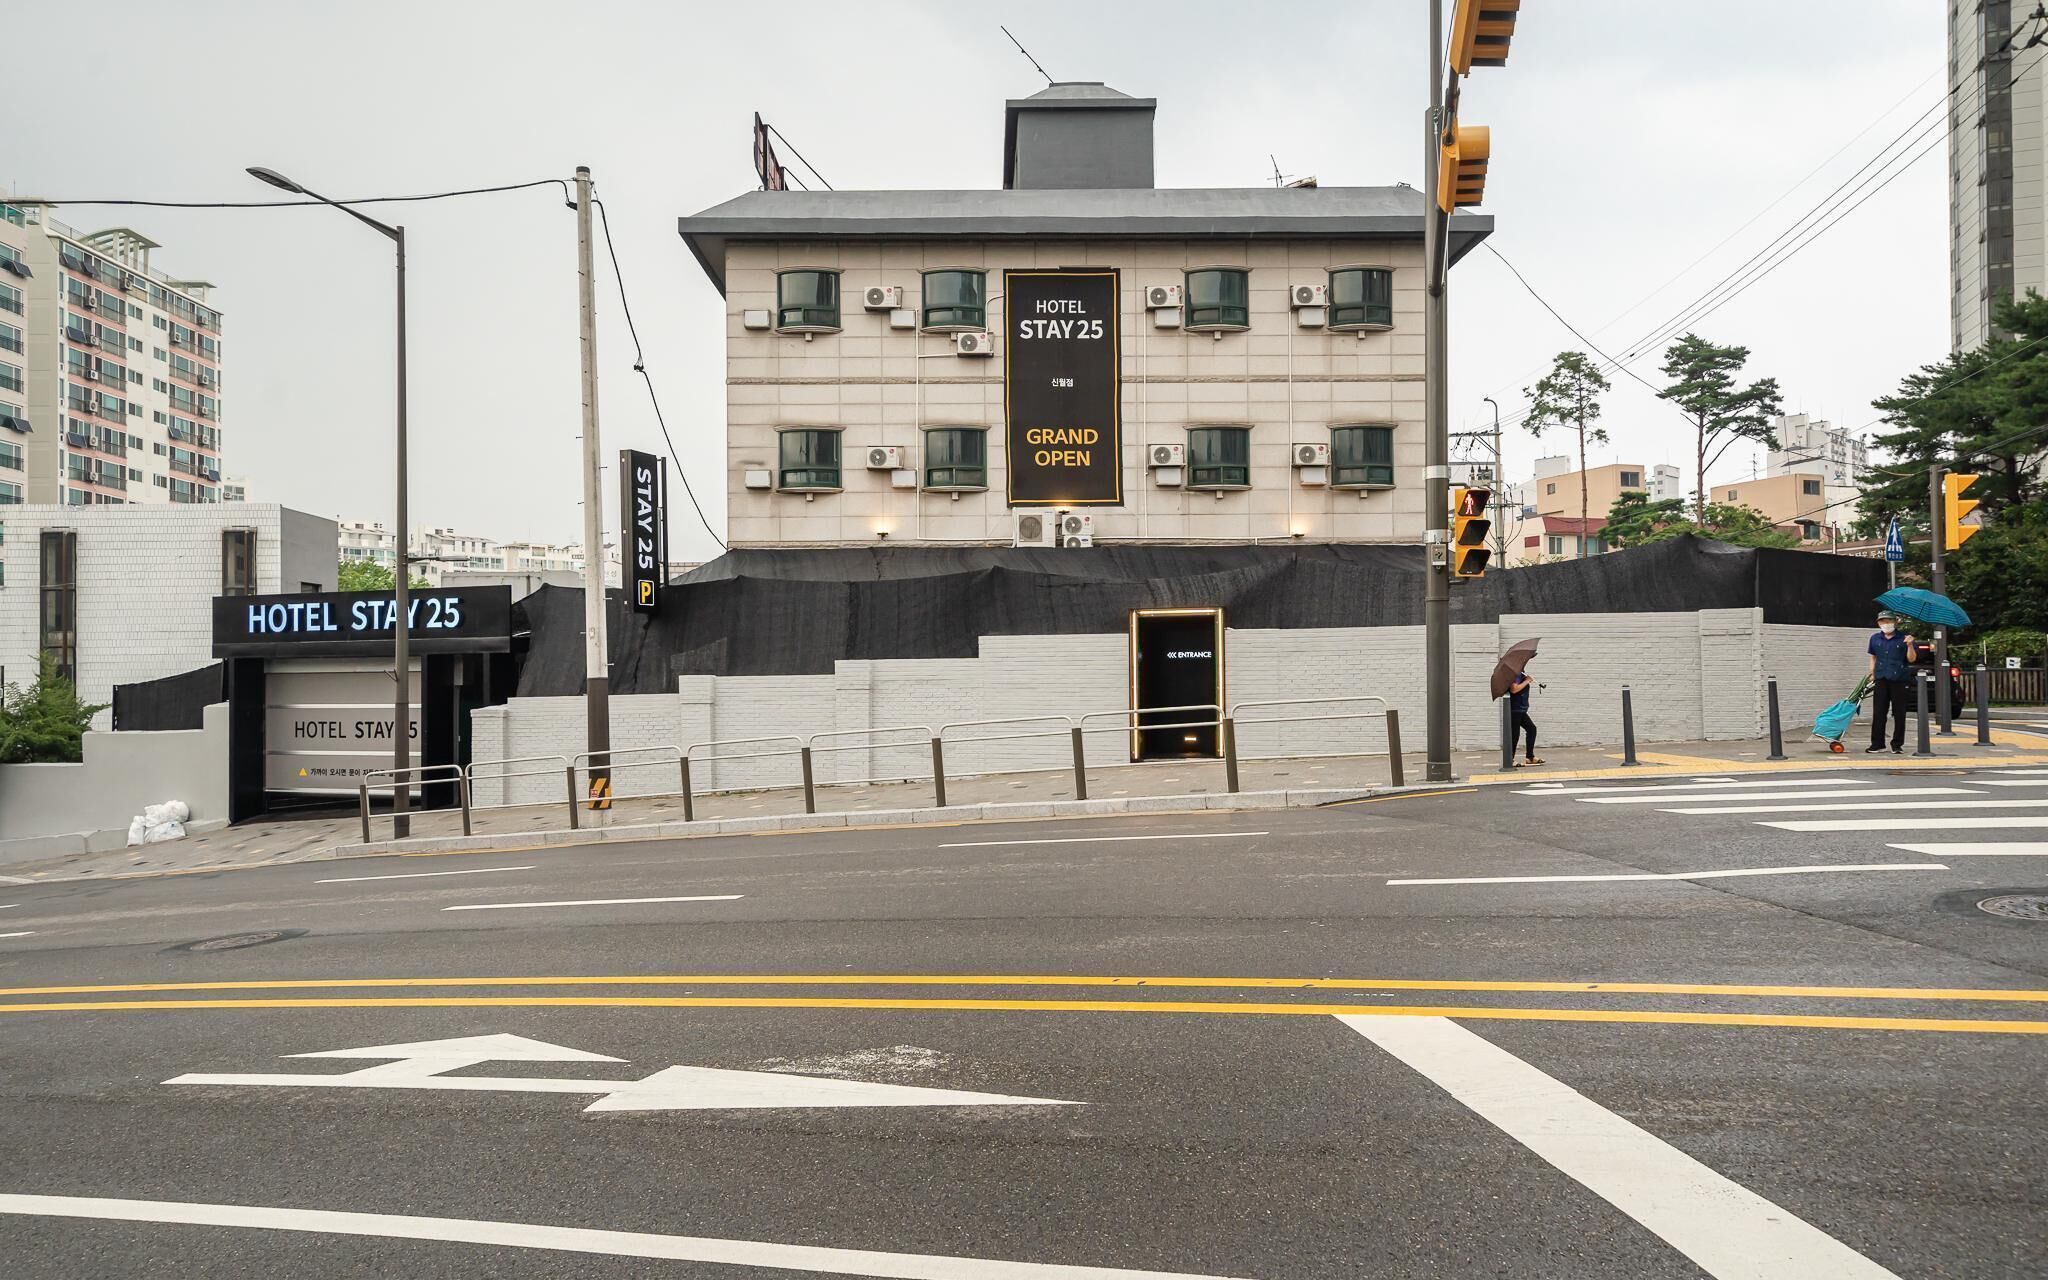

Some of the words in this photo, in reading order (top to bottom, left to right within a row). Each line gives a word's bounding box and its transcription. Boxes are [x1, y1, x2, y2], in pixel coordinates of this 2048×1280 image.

[1036, 300, 1087, 314] HOTEL
[1020, 319, 1074, 339] STAY
[1077, 319, 1104, 339] 25
[1051, 378, 1074, 387] 신월점
[1026, 428, 1099, 445] GRAND
[1034, 450, 1091, 467] OPEN
[637, 466, 653, 534] STAY
[638, 537, 653, 569] 25
[641, 582, 652, 604] P
[249, 602, 338, 633] HOTEL
[351, 598, 420, 631] STAY
[426, 597, 461, 629] 25
[295, 721, 347, 739] HOTEL
[354, 721, 395, 739] STAY
